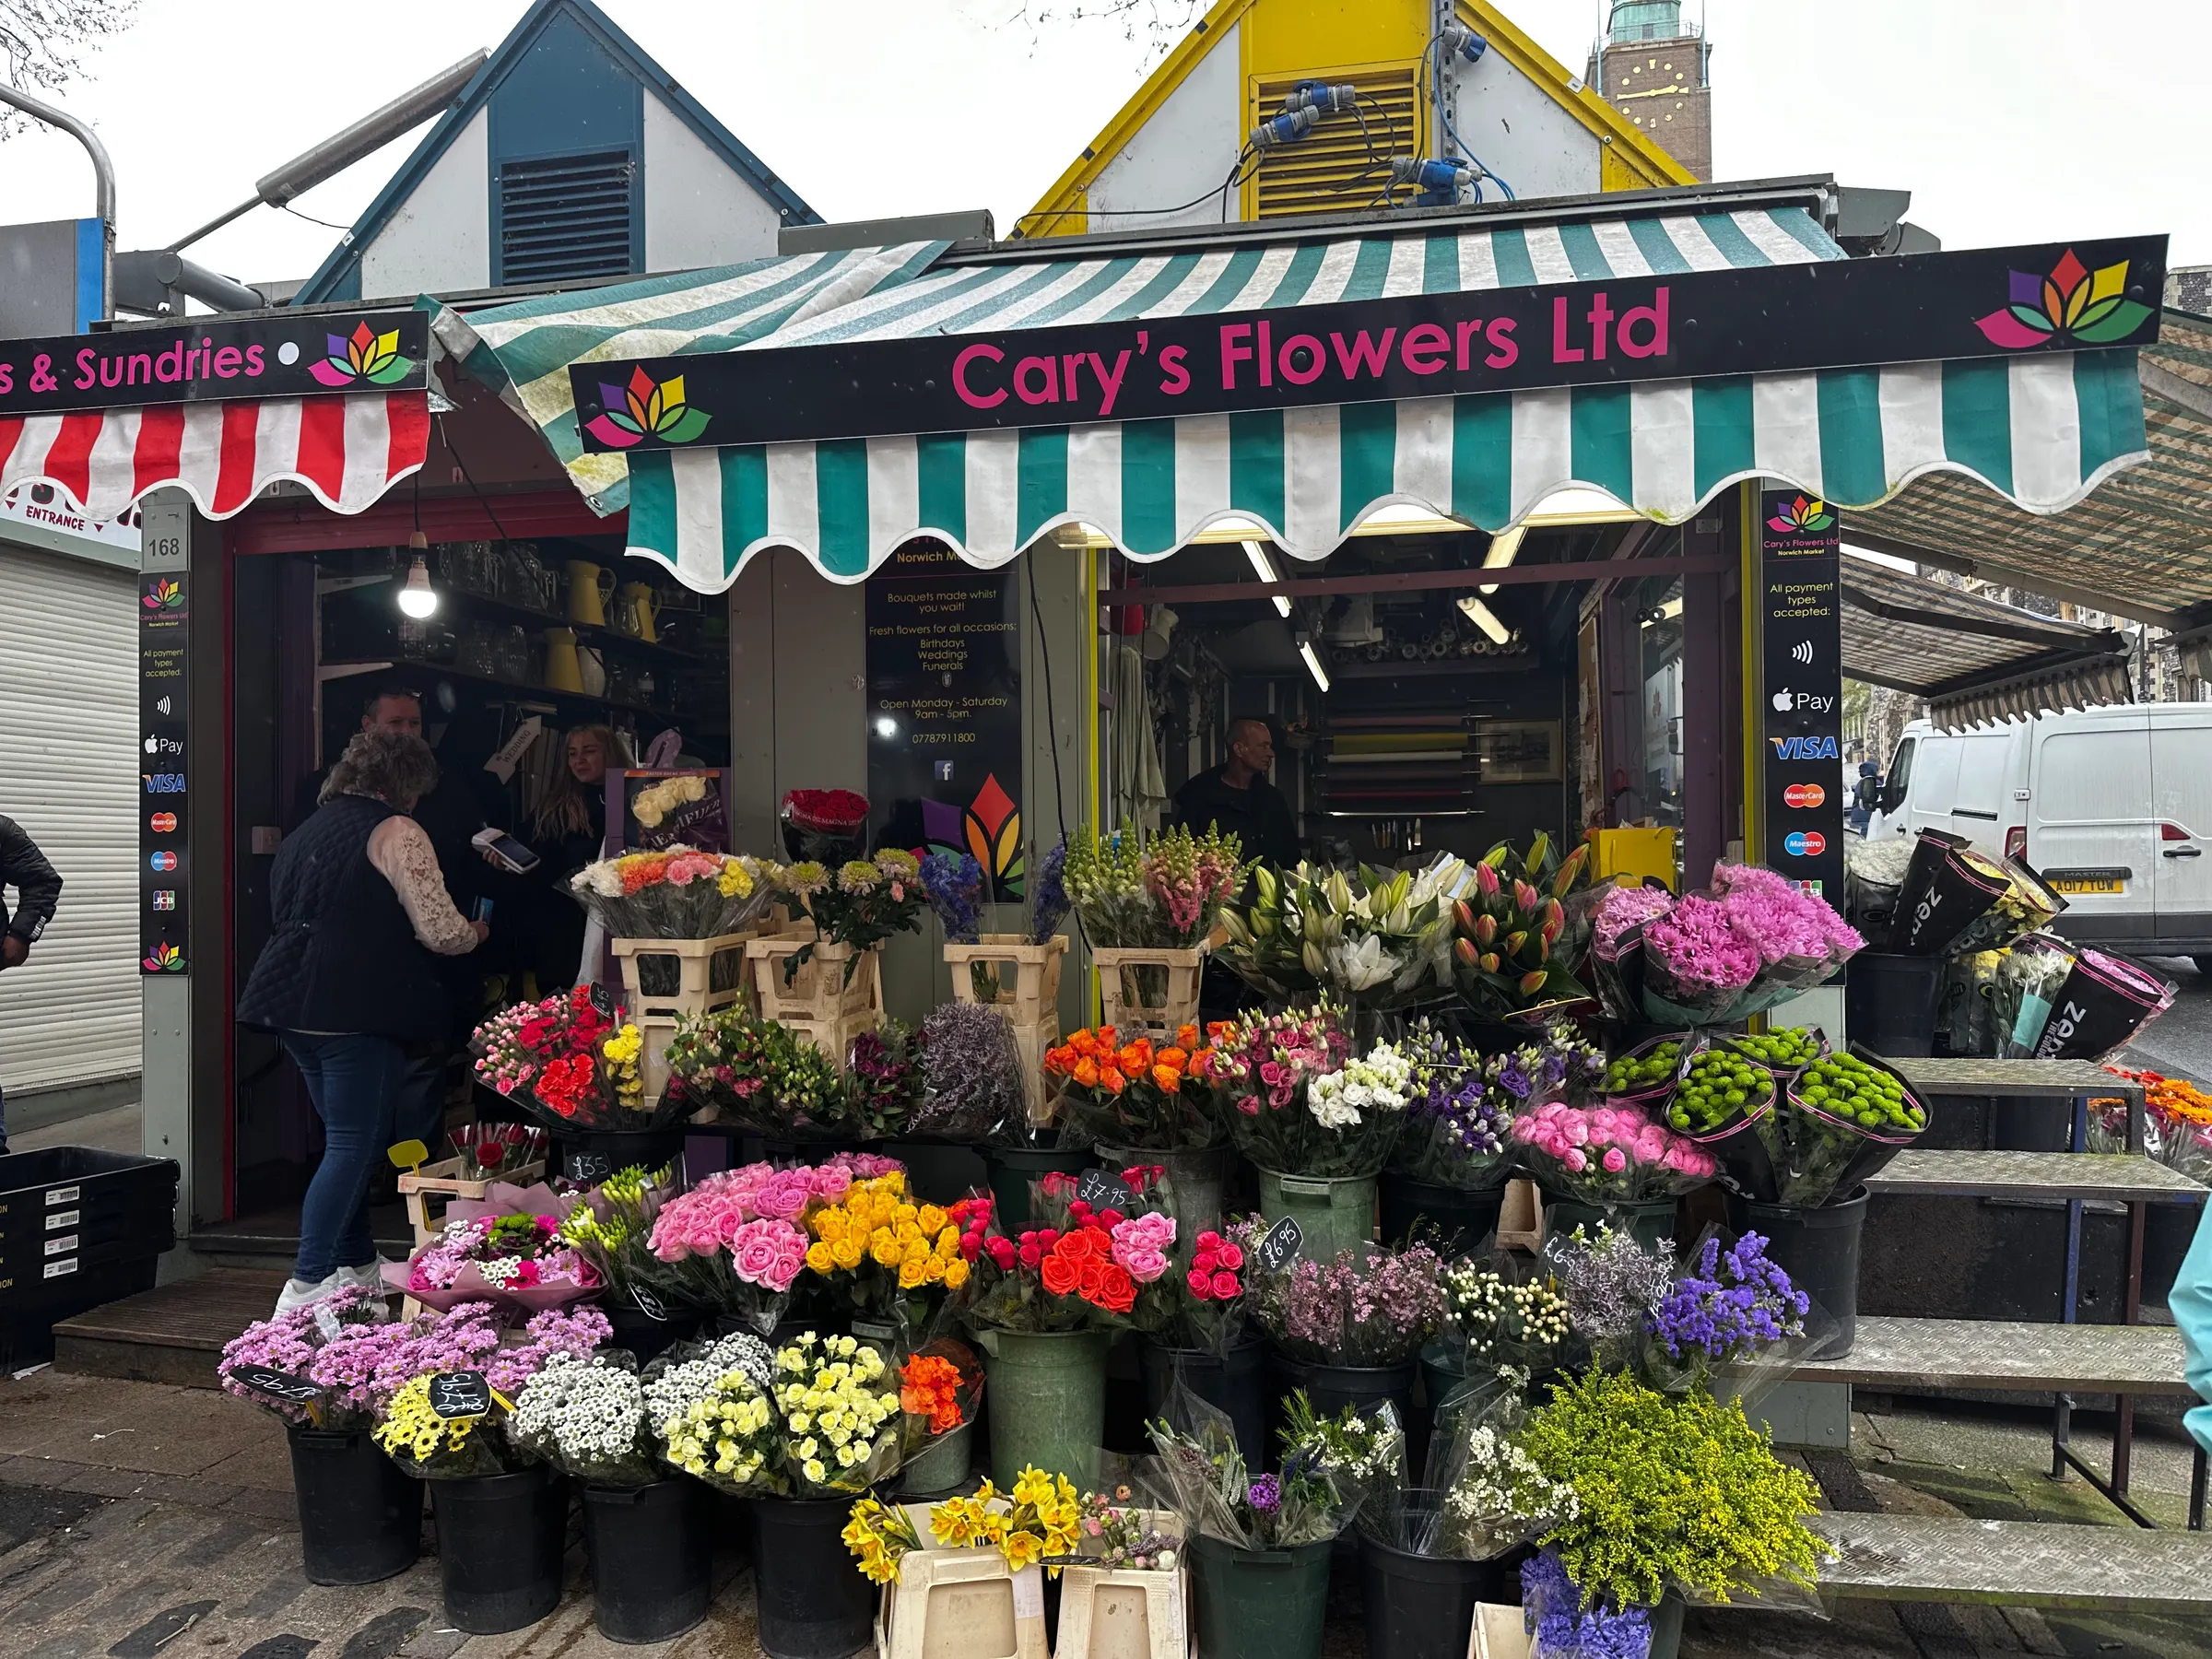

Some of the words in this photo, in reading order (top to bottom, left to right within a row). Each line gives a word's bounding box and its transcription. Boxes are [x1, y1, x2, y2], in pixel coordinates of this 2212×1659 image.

[952, 331, 1192, 416] Cary's
[1219, 317, 1520, 390] Flowers
[1552, 288, 1670, 363] Ltd
[29, 354, 58, 394] &
[75, 337, 265, 391] Sundries
[26, 505, 86, 532] ENTRANCE
[148, 537, 180, 559] 168
[1764, 539, 1790, 548] Cary's
[1793, 538, 1824, 547] Flowers
[1826, 537, 1839, 546] Ltd
[897, 551, 943, 563] Norwich
[1770, 584, 1783, 593] All
[1785, 582, 1833, 594] payment
[888, 592, 934, 604] Bouquets
[936, 591, 967, 601] made
[970, 589, 996, 599] whilst
[1788, 595, 1817, 606] types
[919, 605, 937, 615] you
[941, 602, 965, 612] wait!
[1773, 606, 1831, 618] accepted:
[869, 627, 894, 636] Fresh
[897, 626, 931, 635] flowers
[933, 625, 946, 633] for
[949, 624, 960, 632] all
[963, 622, 1018, 632] occasions:
[920, 639, 966, 649] Birthdays
[152, 649, 183, 659] payment
[918, 650, 968, 661] Weddings
[154, 659, 173, 668] types
[923, 662, 964, 671] Funerals
[880, 700, 909, 710] Open
[911, 699, 954, 709] Monday
[962, 697, 1008, 707] Saturday
[1797, 693, 1834, 713] Pay
[914, 710, 938, 719] 9am
[912, 733, 976, 744] 07787911800
[159, 738, 183, 756] Pay
[501, 730, 532, 763] WEDDING
[1769, 735, 1839, 760] VISA
[142, 774, 186, 793] VISA
[1785, 791, 1824, 801] MasterCard
[1789, 839, 1821, 848] Maestro
[153, 896, 174, 904] JCB
[2047, 1021, 2059, 1036] THE
[572, 1156, 608, 1180] £35
[1080, 1172, 1129, 1206] £7.95
[1265, 1222, 1297, 1269] £6.95
